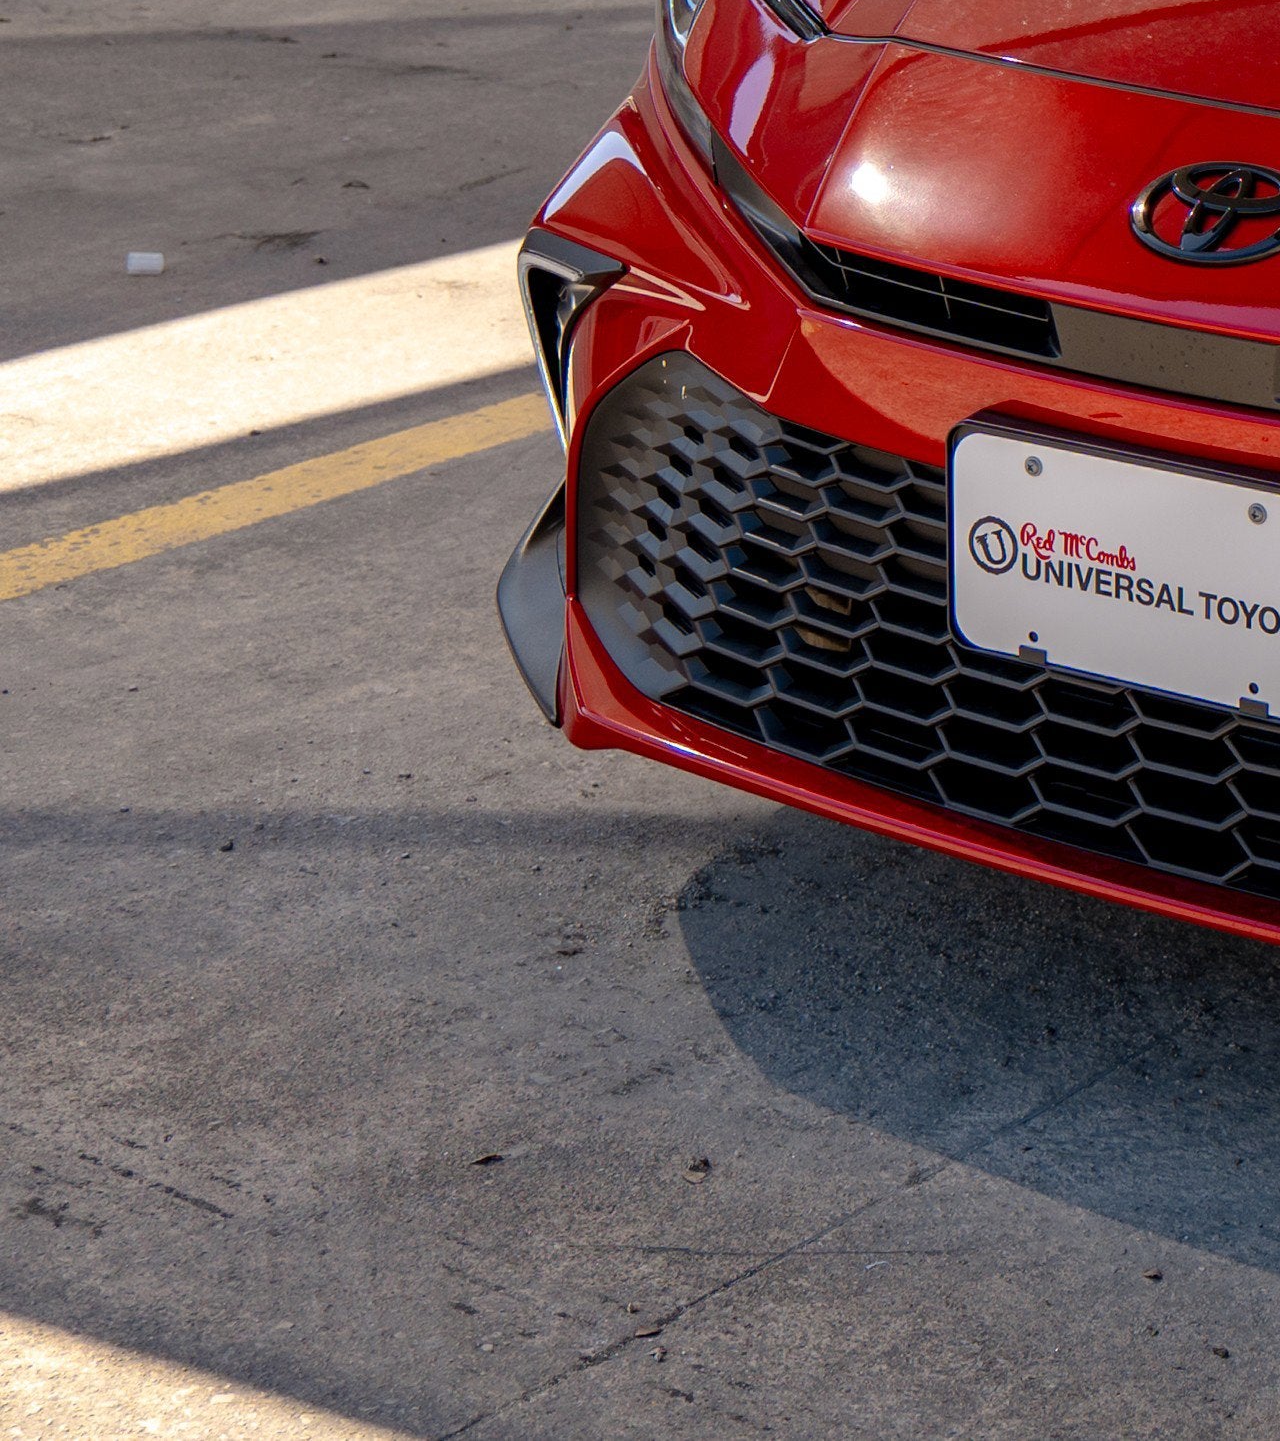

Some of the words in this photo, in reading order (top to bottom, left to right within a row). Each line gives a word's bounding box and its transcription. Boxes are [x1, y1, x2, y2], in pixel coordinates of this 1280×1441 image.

[1020, 522, 1055, 560] Red
[1058, 531, 1137, 572] McCombs
[1021, 553, 1194, 616] UNIVERSAL
